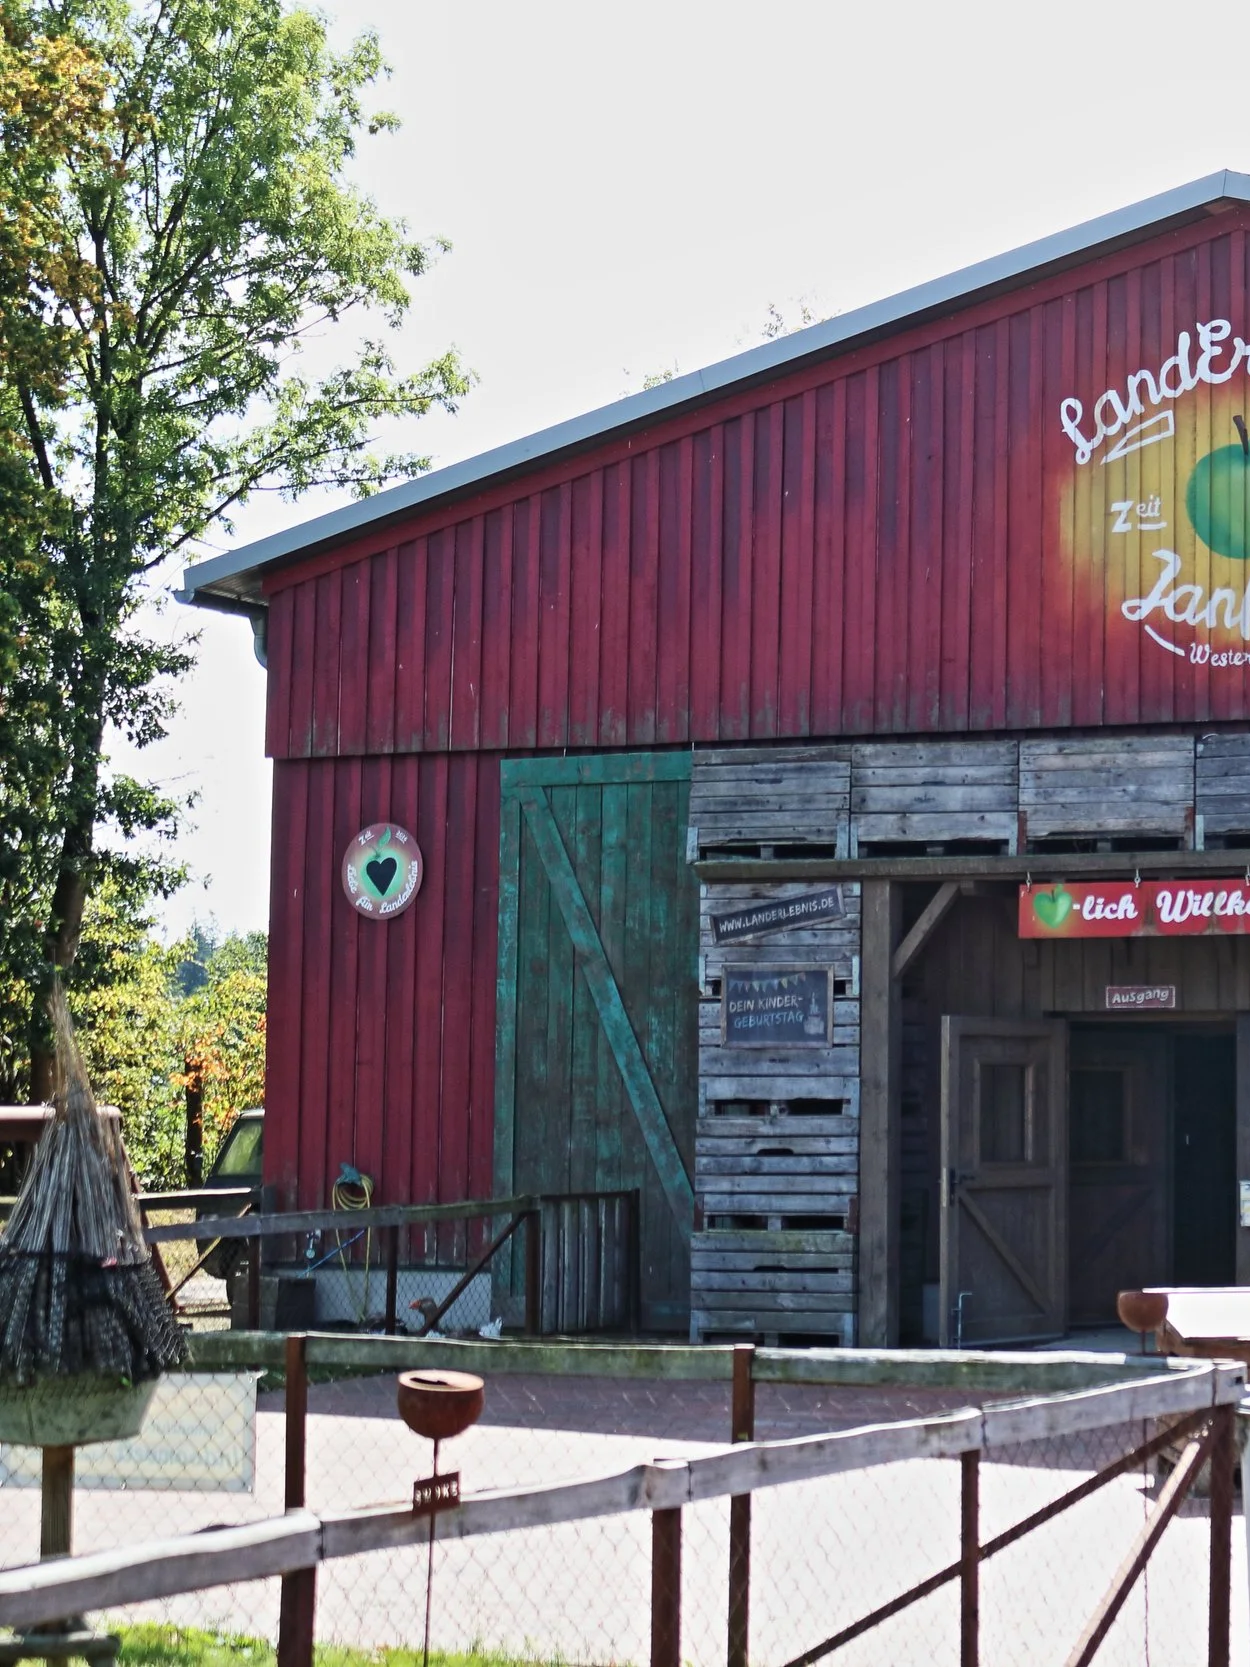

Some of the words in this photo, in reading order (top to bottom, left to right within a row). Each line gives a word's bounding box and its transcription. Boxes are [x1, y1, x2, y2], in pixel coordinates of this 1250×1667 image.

[719, 897, 835, 934] WWW.LANDERLEBNIS.DE
[729, 998, 755, 1013] DEIN
[758, 995, 804, 1010] KINDER-
[1112, 989, 1169, 1004] Ausgang
[734, 1011, 804, 1029] GEBURTSTAG
